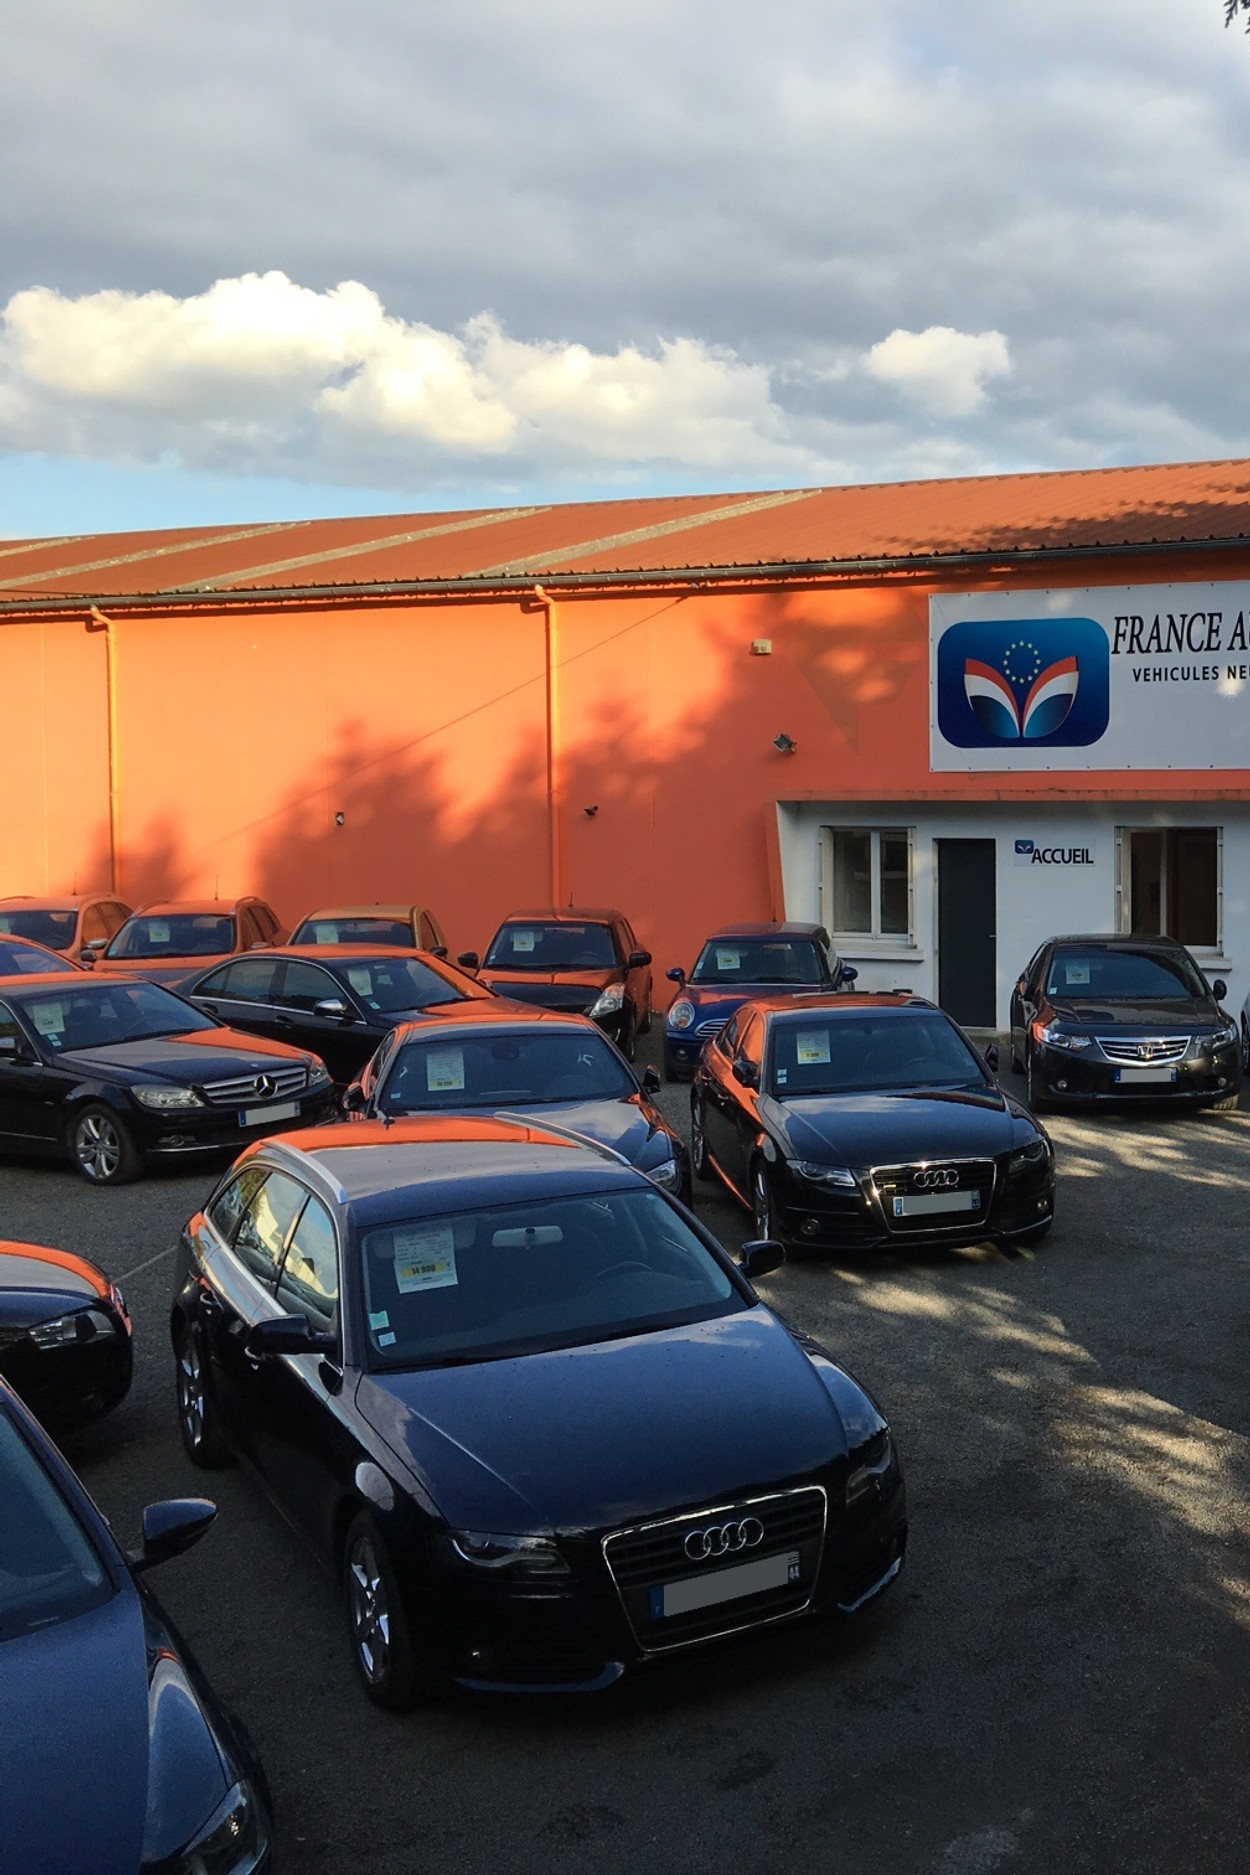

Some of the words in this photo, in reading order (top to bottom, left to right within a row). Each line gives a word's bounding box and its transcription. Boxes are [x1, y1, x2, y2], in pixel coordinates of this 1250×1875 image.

[1111, 612, 1222, 654] FRANCE
[1133, 666, 1219, 682] VEHICULES
[1031, 848, 1094, 865] ACCUEIL
